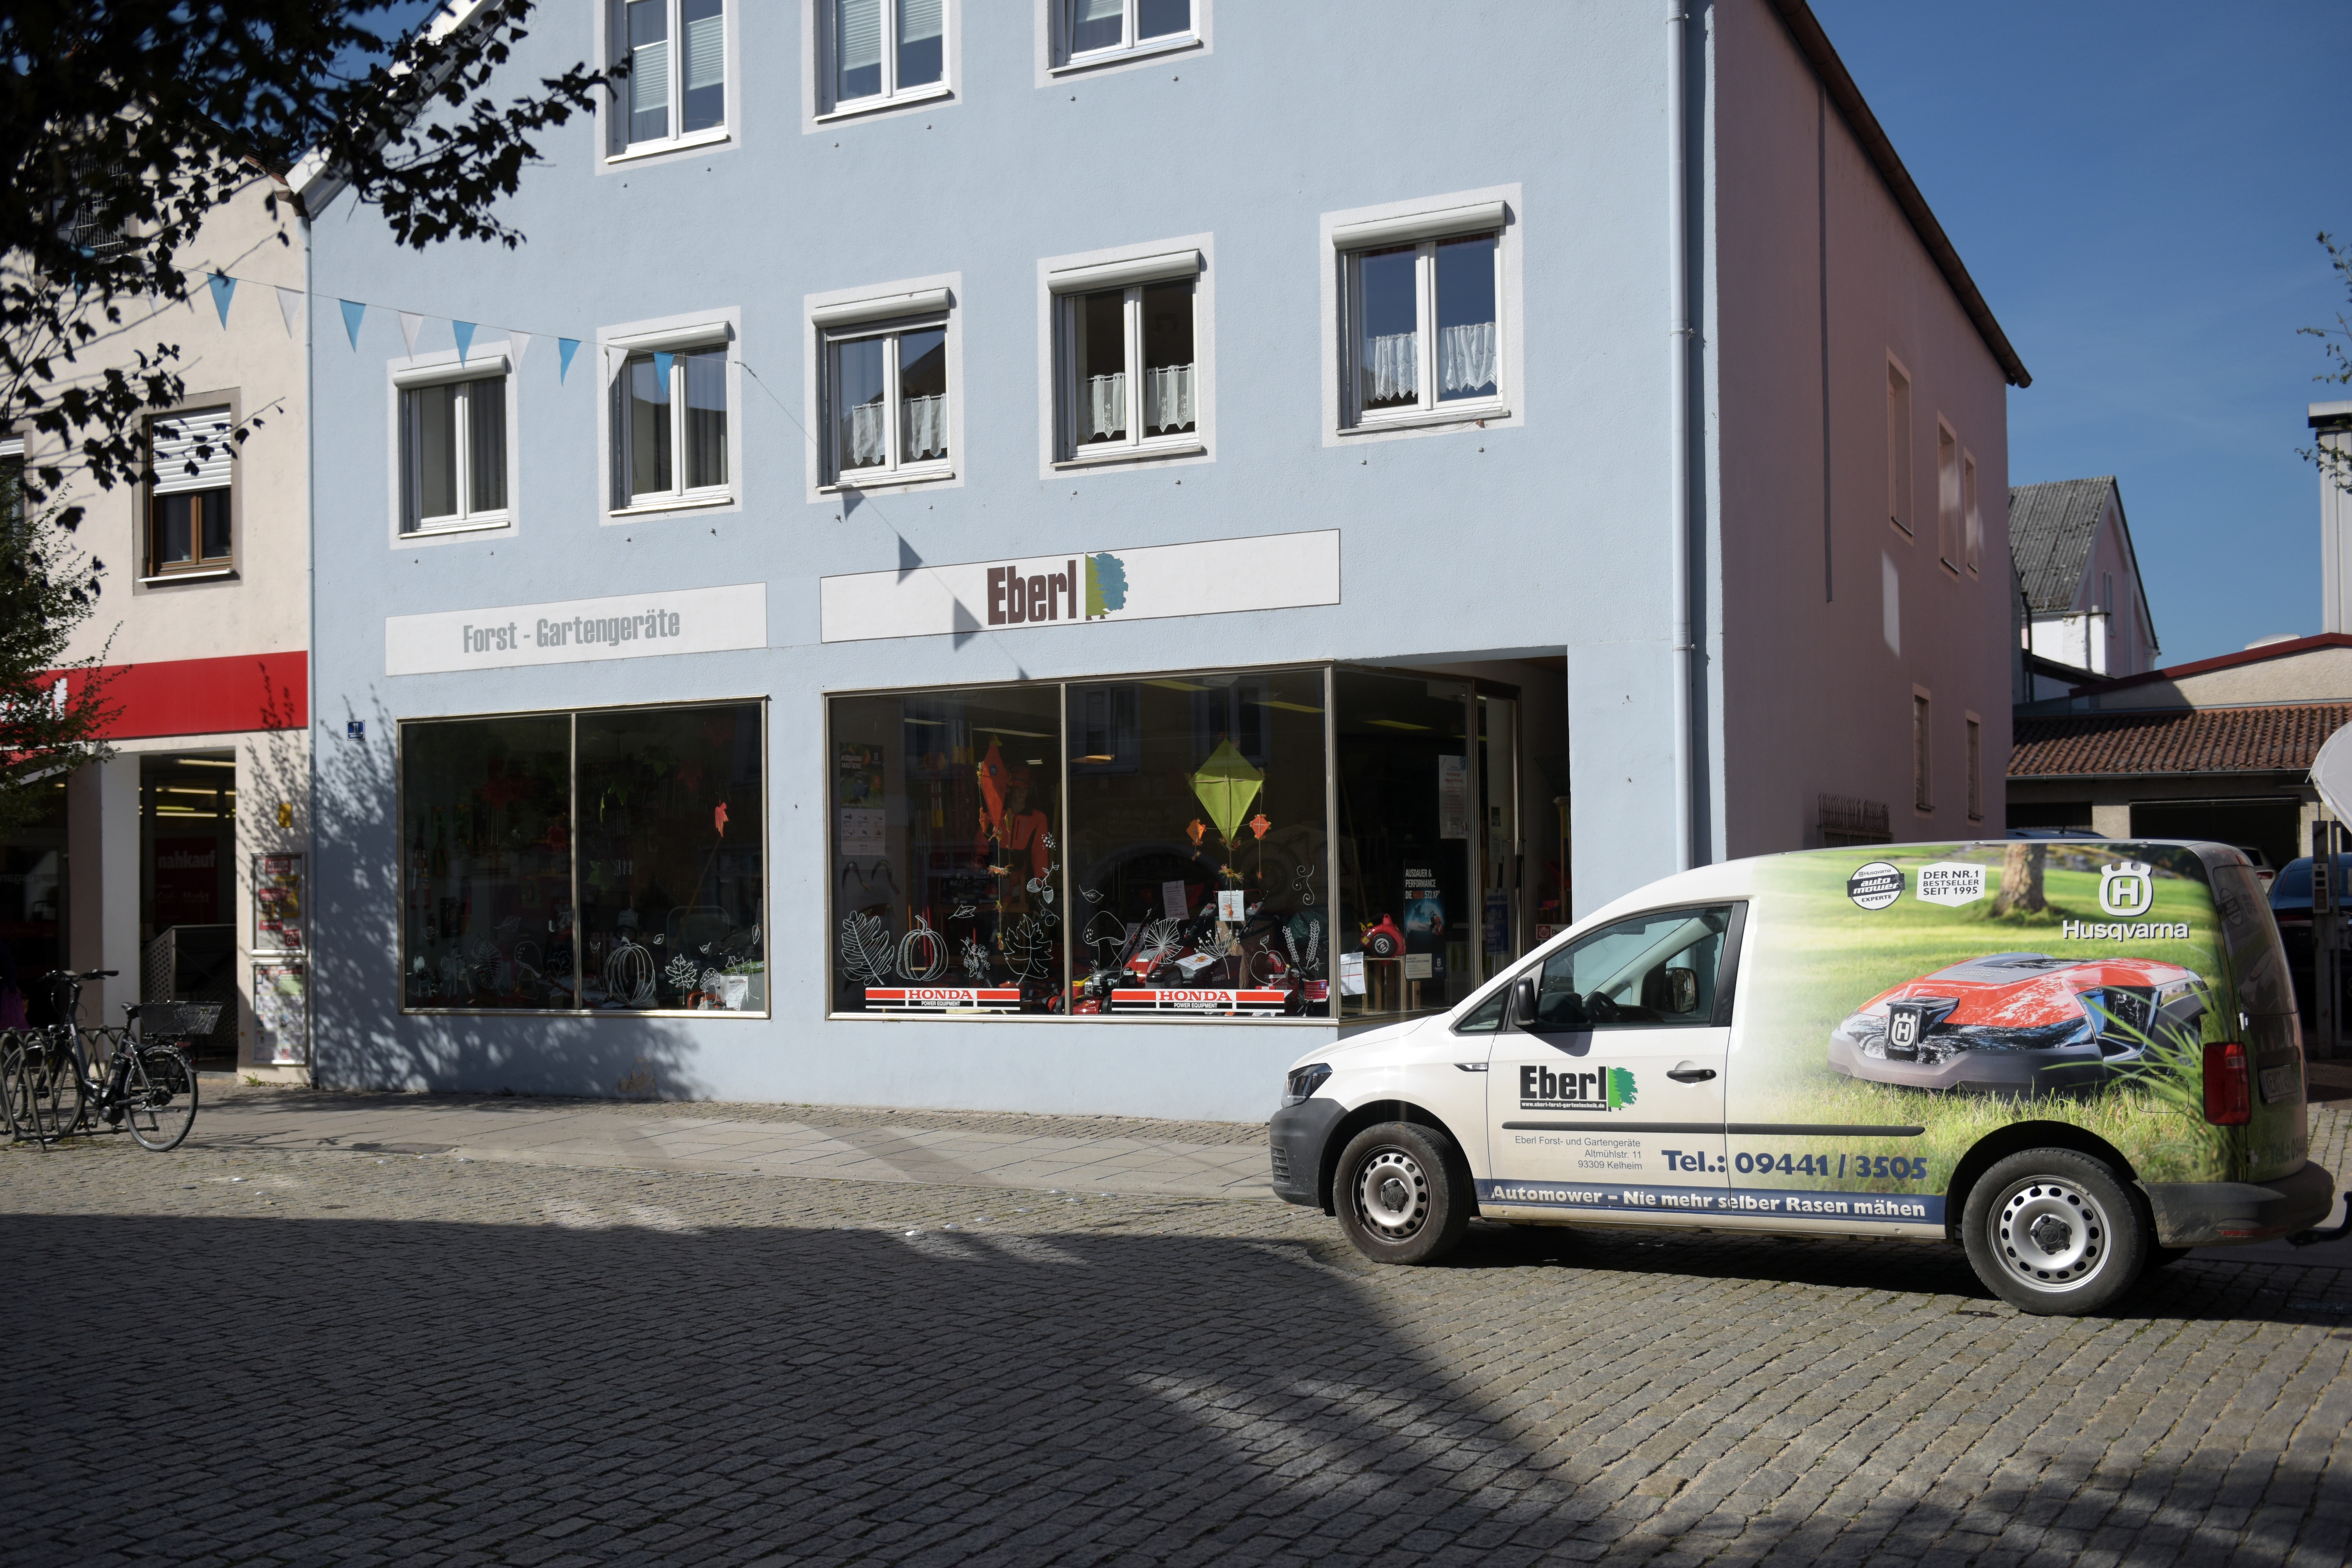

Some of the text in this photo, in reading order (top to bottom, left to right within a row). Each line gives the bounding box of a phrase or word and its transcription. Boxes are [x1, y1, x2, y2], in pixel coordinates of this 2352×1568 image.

[987, 560, 1077, 625] Eberl
[463, 624, 518, 653] Forst
[536, 609, 680, 646] Gartengeräte
[353, 723, 359, 733] 11
[158, 849, 216, 869] nahkauf
[1405, 869, 1432, 878] AUSDAUER &
[1923, 871, 1948, 879] DER
[1405, 879, 1436, 888] PERFORMANCE
[1860, 878, 1891, 887] auto
[1853, 883, 1899, 894] mower
[1923, 886, 1977, 895] SEIT 1995
[1413, 890, 1424, 899] NEUE
[1861, 894, 1892, 902] EXPERTE
[2062, 920, 2189, 942] Husqvarna
[907, 990, 974, 999] HONDA
[1159, 991, 1232, 1001] HONDA
[1520, 1065, 1607, 1100] Eberl
[1515, 1136, 1536, 1144] Eberl
[1539, 1137, 1563, 1145] Forst-
[1584, 1138, 1641, 1148] Gartengeräte
[1585, 1149, 1629, 1158] Altmühlstr.
[1578, 1160, 1642, 1170] 93309 Kelheim
[1661, 1150, 1927, 1179] Tel.: 09441 / 3505
[1491, 1185, 1603, 1203] Automower
[1623, 1191, 1656, 1205] Nie
[1662, 1193, 1712, 1207] mehr
[1718, 1196, 1780, 1210] selber
[1786, 1197, 1847, 1213] Rasen
[1854, 1199, 1925, 1217] mähen
